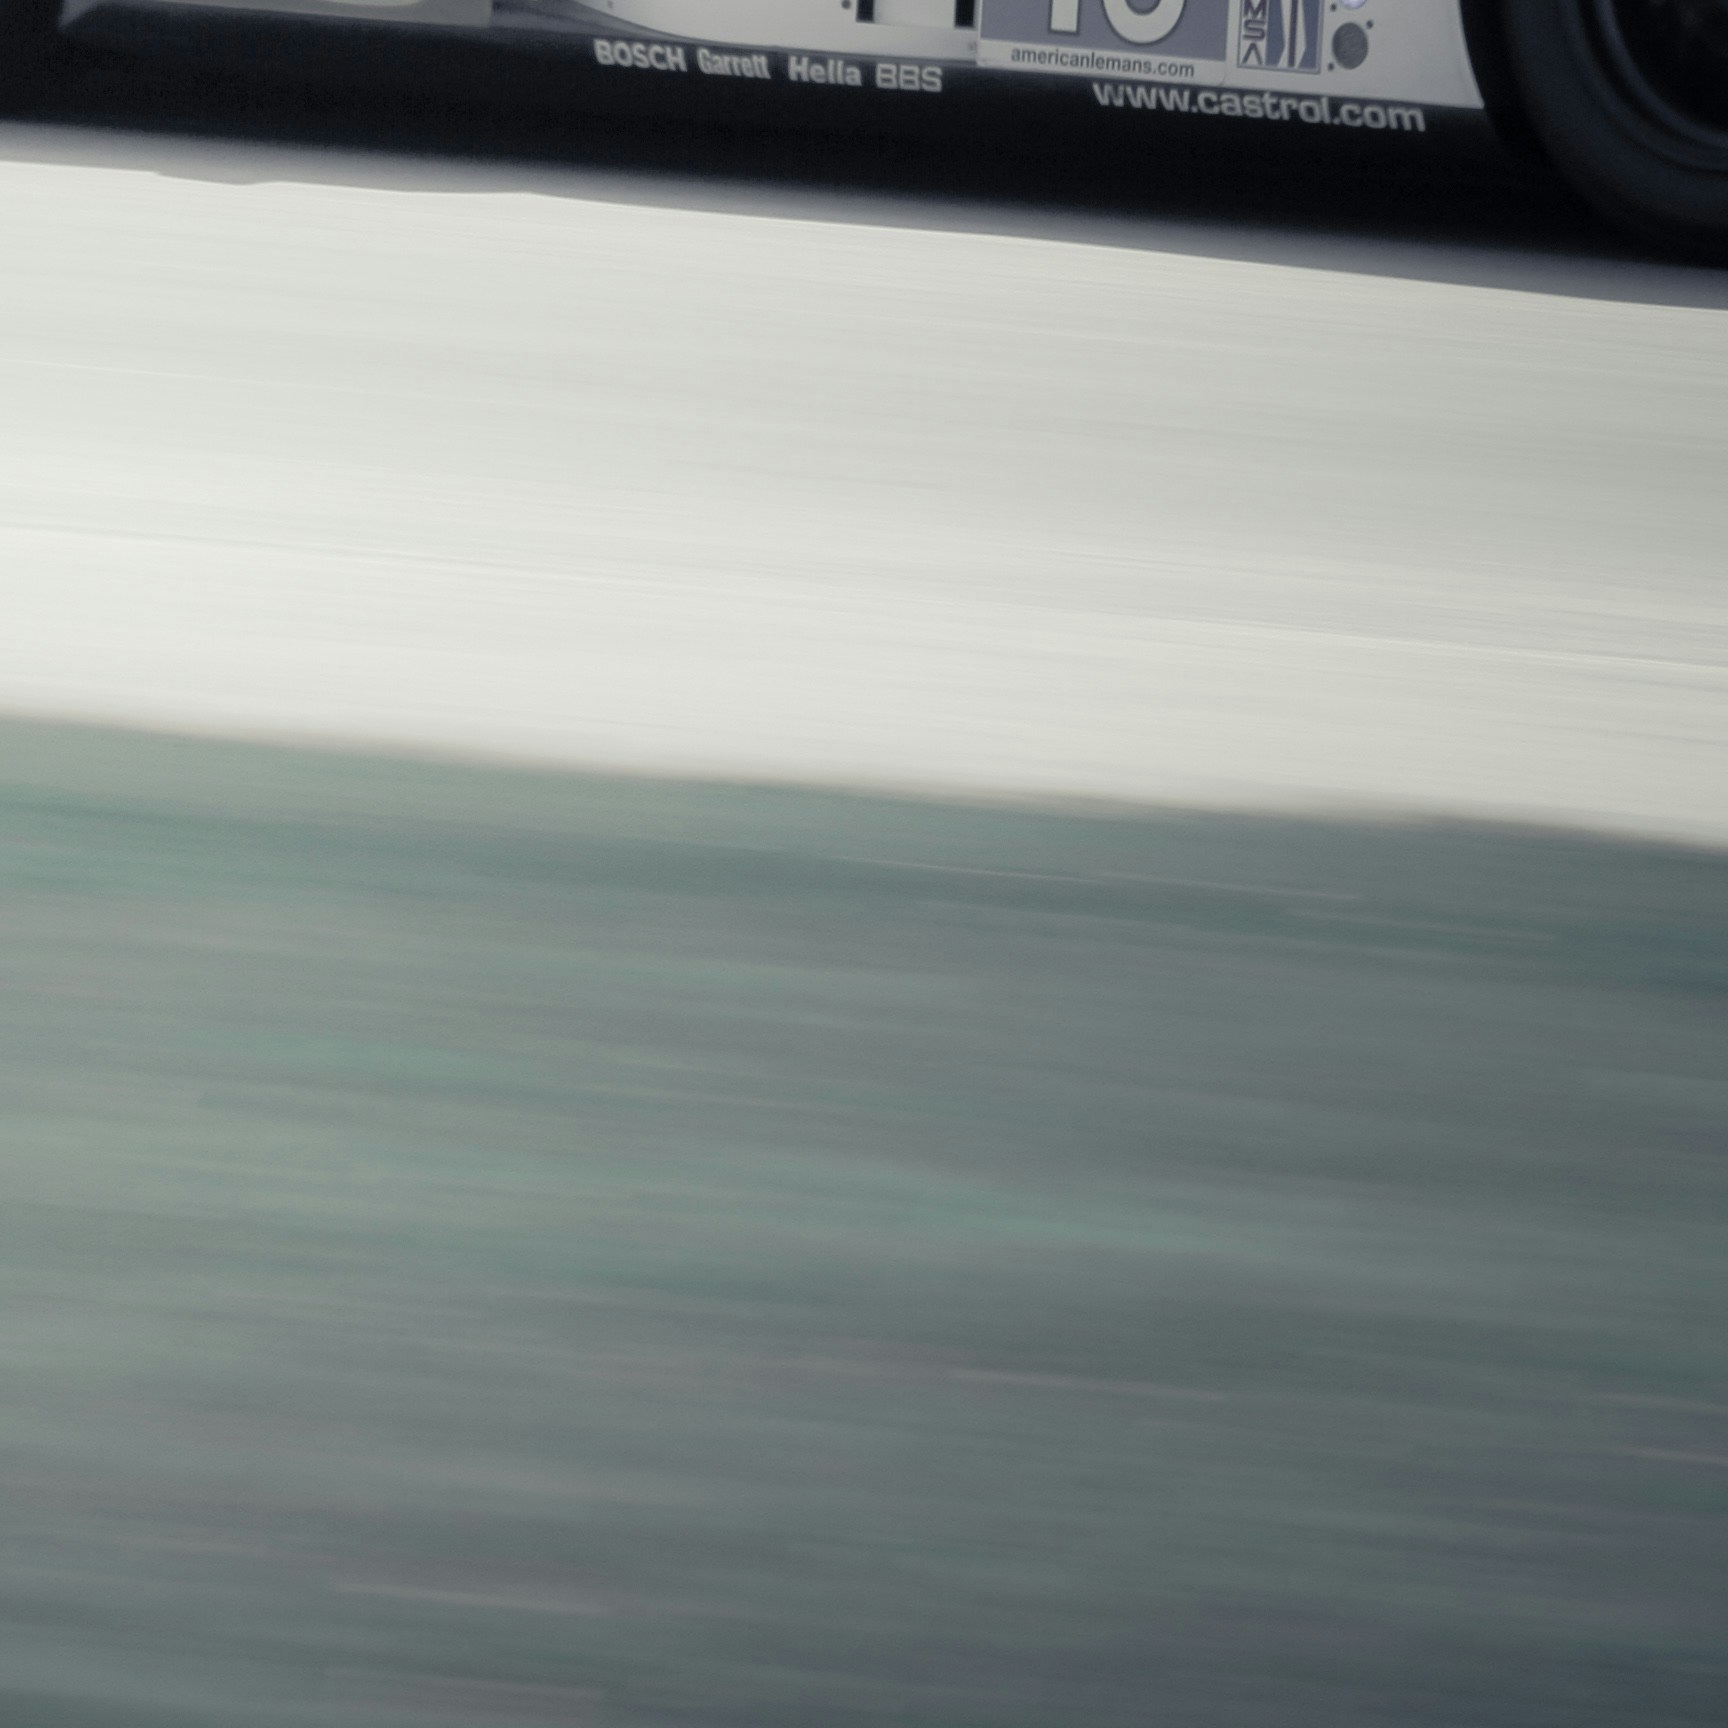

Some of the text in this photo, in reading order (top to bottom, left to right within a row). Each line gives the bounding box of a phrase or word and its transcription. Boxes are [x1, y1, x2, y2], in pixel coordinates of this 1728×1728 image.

[594, 38, 943, 92] BOSCH Garrett Hella BBS
[1010, 45, 1195, 79] americanlemans.com
[1092, 81, 1426, 132] www.castrol.com
